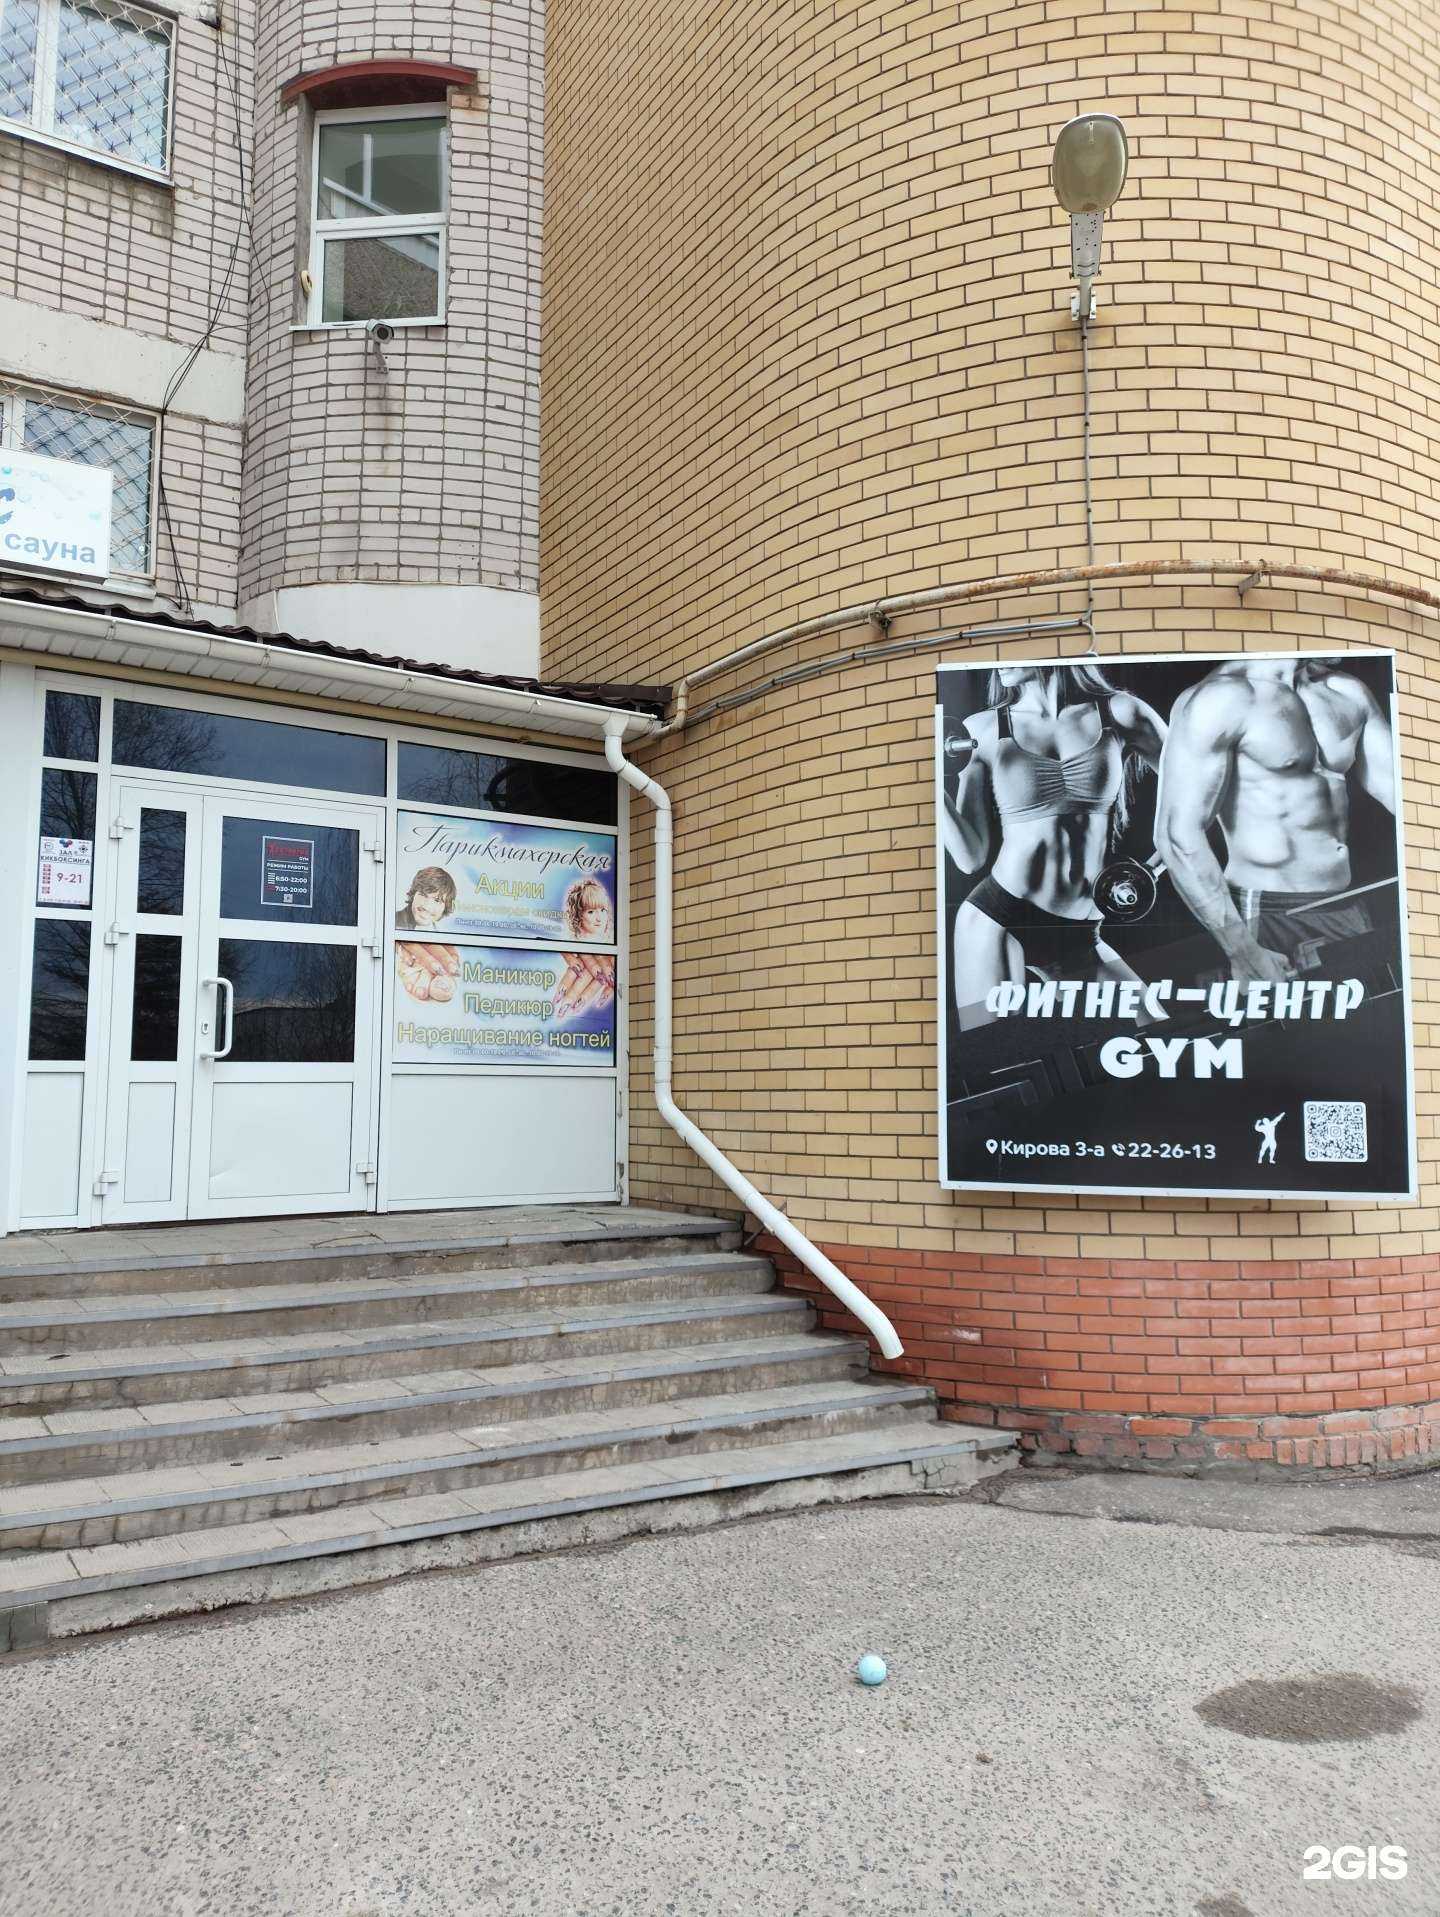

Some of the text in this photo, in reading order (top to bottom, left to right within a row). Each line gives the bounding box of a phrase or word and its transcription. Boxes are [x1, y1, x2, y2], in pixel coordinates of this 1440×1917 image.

[4, 532, 96, 565] сауна
[404, 824, 610, 875] Парикмахерская
[56, 872, 82, 884] 9-21
[474, 872, 545, 900] Акции
[462, 960, 556, 991] Маникюр
[463, 991, 554, 1021] Педикюр
[984, 977, 1365, 1028] ФИТНЕС-ЦЕНТР
[397, 1021, 611, 1049] Наращивание ногтей
[1099, 1036, 1244, 1080] GYM
[1000, 1139, 1217, 1160] Кирова 3-а 22-26-13
